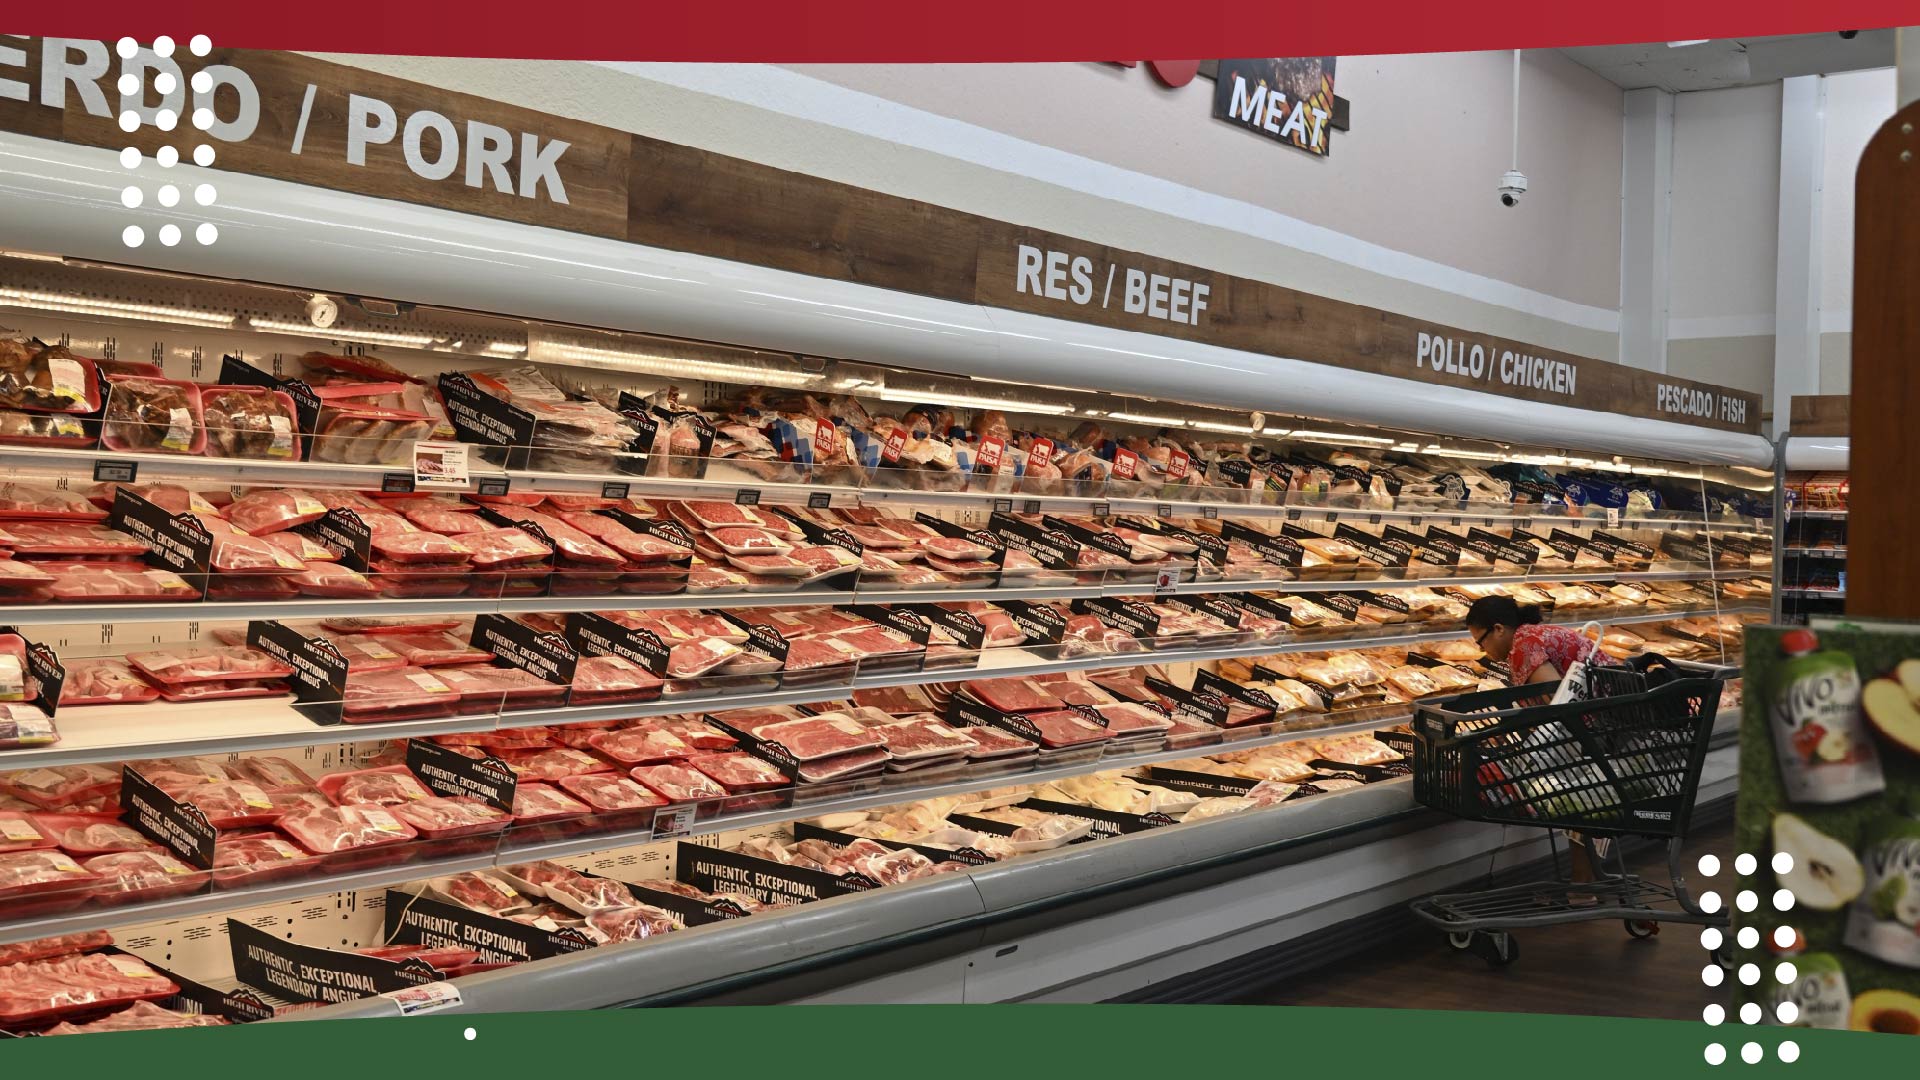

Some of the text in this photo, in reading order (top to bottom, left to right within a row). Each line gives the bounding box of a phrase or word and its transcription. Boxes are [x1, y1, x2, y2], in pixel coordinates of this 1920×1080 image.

[1229, 76, 1328, 147] MEAT
[347, 94, 571, 205] PORK
[1017, 245, 1093, 305] RES
[1124, 268, 1210, 326] BEEF
[1417, 332, 1484, 379] POLLO
[1501, 351, 1577, 395] CHICKEN
[1657, 384, 1713, 418] PESCADO
[1722, 397, 1746, 424] FISH
[456, 412, 486, 435] LEGENDARY
[486, 429, 507, 444] ANGUS
[170, 518, 210, 546] HIGH RIVER
[328, 513, 369, 538] HIGH RIVER
[649, 526, 692, 549] HIGH RIVER
[123, 514, 196, 564] AUTHENTIC, EXCEPTIONAL,
[320, 524, 356, 554] EXCEPTIONAL,
[823, 532, 861, 554] HIGH RIVER
[966, 532, 1004, 552] HIGH RIVER
[1000, 528, 1065, 561] AUTHENTIC, EXCEPTIONAL,
[1042, 532, 1080, 550] HIGH RIVER
[1093, 535, 1131, 552] HIGH RIVER
[164, 549, 184, 568] ANGUS
[1038, 551, 1055, 564] ANGUS
[1028, 608, 1064, 626] HIGH RIVER
[1122, 604, 1158, 622] HIGH RIVER
[1205, 601, 1240, 618] HIGH RIVER
[888, 613, 928, 633] HIGH RIVER
[946, 613, 984, 633] HIGH RIVER
[1016, 615, 1050, 638] EXCEPTIONAL,
[1022, 627, 1040, 640] ANGUS
[1112, 612, 1144, 632] EXCEPTIONAL,
[1118, 623, 1136, 634] ANGUS
[534, 636, 576, 662] HIGH RIVER
[579, 626, 654, 670] AUTHENTIC, EXCEPTIONAL,
[626, 632, 669, 656] HIGH RIVER
[748, 627, 766, 641] HIGH
[765, 633, 787, 650] RIVER
[258, 635, 331, 686] AUTHENTIC, EXCEPTIONAL,
[304, 641, 346, 670] HIGH RIVER
[486, 628, 560, 676] AUTHENTIC, EXCEPTIONAL,
[492, 644, 548, 680] LEGENDARY ANGUS
[41, 660, 62, 680] RIVER
[300, 672, 321, 690] ANGUS
[1003, 716, 1020, 730] HIGH
[1020, 723, 1040, 738] RIVER
[756, 742, 774, 757] HIGH
[774, 751, 798, 767] RIVER
[420, 763, 500, 802] AUTHENTIC, EXCEPTIONAL,
[472, 763, 515, 785] HIGH RIVER
[132, 794, 200, 854] AUTHENTIC, EXCEPTIONAL,
[140, 811, 191, 857] LEGENDARY ANGUS
[174, 805, 214, 840] HIGH RIVER
[696, 861, 821, 901] AUTHENTIC, EXCEPTIONAL,
[835, 880, 855, 892] HIGH
[704, 906, 724, 919] HIGH
[405, 910, 531, 963] AUTHENTIC, EXCEPTIONAL,
[548, 935, 569, 948] HIGH
[248, 944, 381, 996] AUTHENTIC, EXCEPTIONAL,
[394, 970, 416, 982] HIGH
[266, 967, 318, 1000] LEGENDARY
[223, 998, 274, 1020] HIGH RIVER
